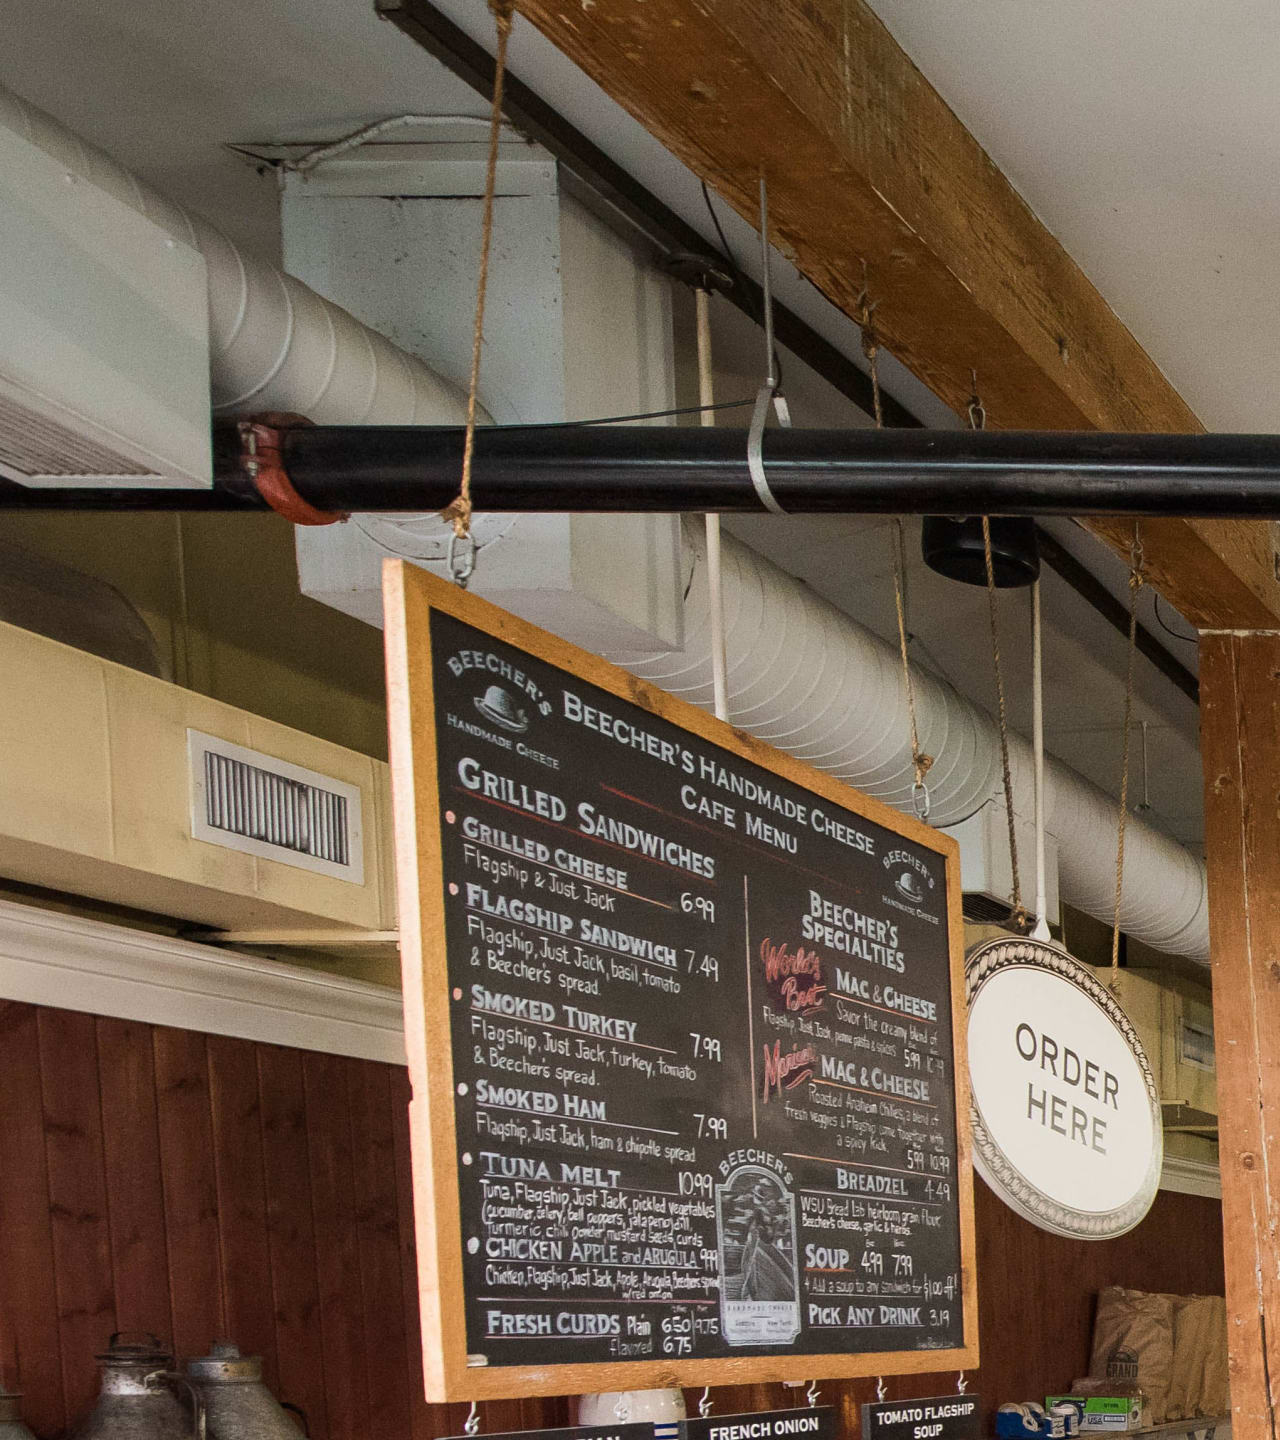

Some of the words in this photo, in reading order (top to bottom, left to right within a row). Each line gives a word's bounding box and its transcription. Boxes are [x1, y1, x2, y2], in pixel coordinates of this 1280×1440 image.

[447, 650, 552, 716] BEECHER'S
[447, 713, 512, 749] HANDMADE
[516, 742, 559, 770] CHEESE
[563, 690, 695, 774] BEECHER'S
[700, 755, 807, 825] HANDMADE
[811, 809, 874, 855] CHEESE
[457, 757, 566, 822] GRILLED
[577, 802, 715, 879] SANDWICHES
[681, 785, 735, 828] CAFE
[746, 811, 797, 854] MENU
[463, 816, 550, 862] GRILLED
[554, 848, 628, 890] CHEESE
[681, 892, 715, 923] 6.99
[464, 844, 528, 889] Flagship
[534, 871, 545, 887] &
[549, 873, 579, 900] Just
[583, 885, 615, 912] Jack
[466, 882, 573, 934] FLAGSHIP
[580, 918, 677, 967] SANDWICH
[685, 949, 718, 982] 7.49
[809, 890, 899, 949] BEECHER'S
[470, 946, 480, 966] &
[488, 950, 550, 984] Beecher's
[540, 936, 571, 965] Just
[642, 965, 681, 994] tomato
[801, 914, 905, 974] SPECIALTIES
[835, 968, 870, 1000] MAC
[873, 985, 882, 1002] &
[883, 987, 937, 1021] CHEESE
[472, 984, 555, 1022] SMOKED
[563, 1005, 637, 1042] TURKEY
[690, 1033, 721, 1061] 7.99
[474, 1045, 486, 1064] &
[489, 1048, 550, 1079] Beecher's
[543, 1031, 570, 1054] Just
[657, 1057, 696, 1081] tomato
[821, 1054, 856, 1085] MAC
[861, 1069, 869, 1086] &
[871, 1067, 929, 1100] CHEESE
[1016, 1023, 1119, 1110] ORDER
[476, 1079, 558, 1113] SMOKED
[563, 1094, 606, 1121] HAM
[694, 1114, 727, 1140] 7.99
[1027, 1082, 1107, 1155] HERE
[532, 1120, 556, 1143] Just
[591, 1132, 613, 1151] ham
[479, 1152, 551, 1181] TUNA
[560, 1163, 621, 1188] MELT
[678, 1172, 713, 1199] 10.99
[719, 1149, 795, 1185] BEECHER'S
[836, 1168, 908, 1196] BREADZEL
[572, 1188, 599, 1206] Just
[486, 1237, 562, 1261] CHICKEN
[570, 1242, 618, 1263] APPLE
[622, 1250, 641, 1264] and
[642, 1248, 697, 1267] ARUGULA
[677, 1232, 703, 1247] curds
[805, 1244, 849, 1269] SOUP
[861, 1251, 883, 1276] 4.99
[891, 1254, 913, 1275] 7.99
[568, 1267, 591, 1287] Just
[487, 1310, 550, 1334] FRESH
[556, 1312, 620, 1334] CURDS
[627, 1315, 650, 1337] Plain
[809, 1304, 840, 1325] PICK
[847, 1305, 875, 1325] ANY
[880, 1304, 924, 1325] DRINK
[930, 1309, 949, 1327] 3.19
[773, 1417, 820, 1437] ONION
[876, 1409, 922, 1425] TOMATO
[924, 1403, 975, 1420] FLAGSHIP
[913, 1423, 943, 1440] SOUP
